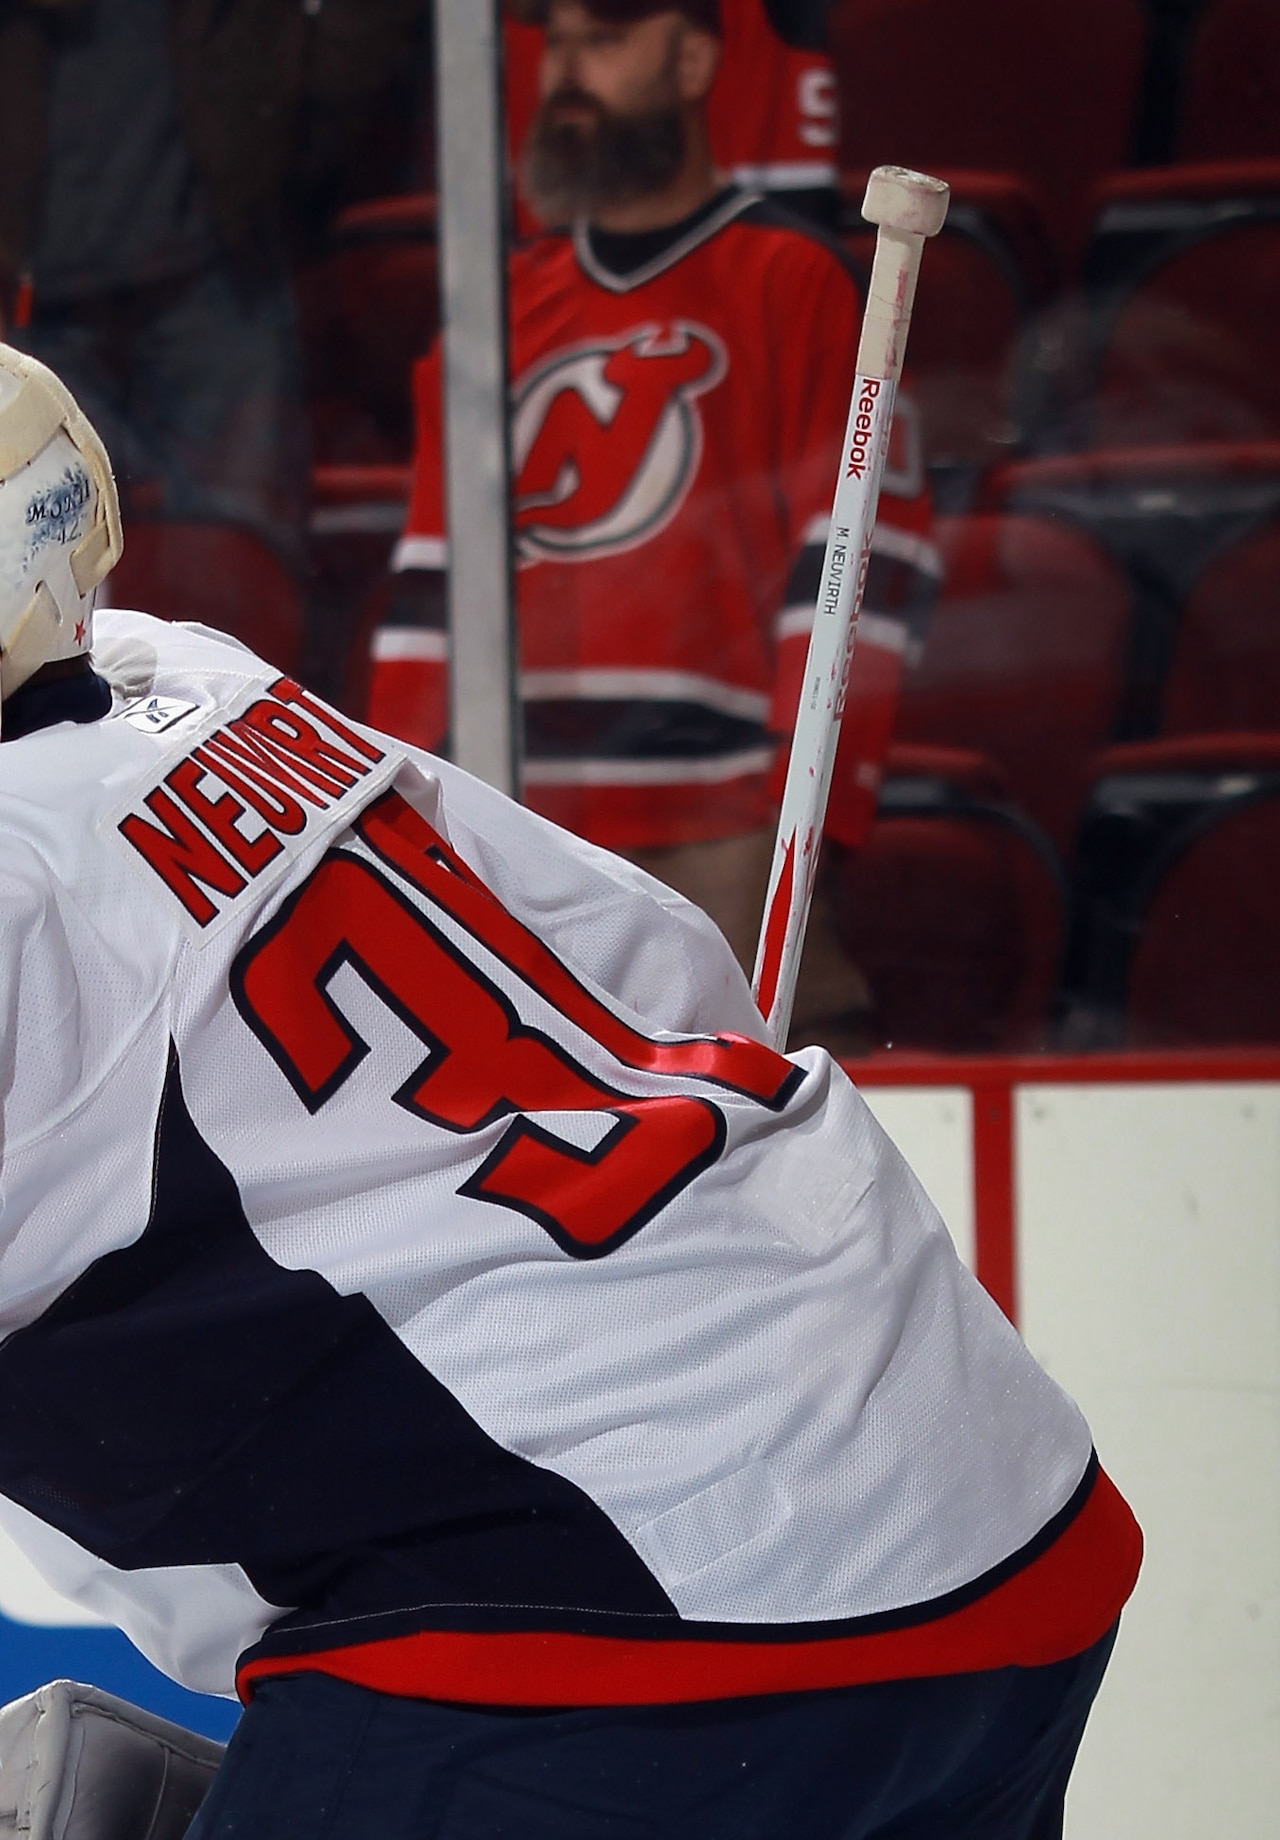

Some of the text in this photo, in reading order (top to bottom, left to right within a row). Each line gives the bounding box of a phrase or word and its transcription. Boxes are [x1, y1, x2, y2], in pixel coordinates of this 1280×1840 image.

[846, 378, 881, 480] Reebok
[823, 527, 850, 616] M. NEUVIRTH
